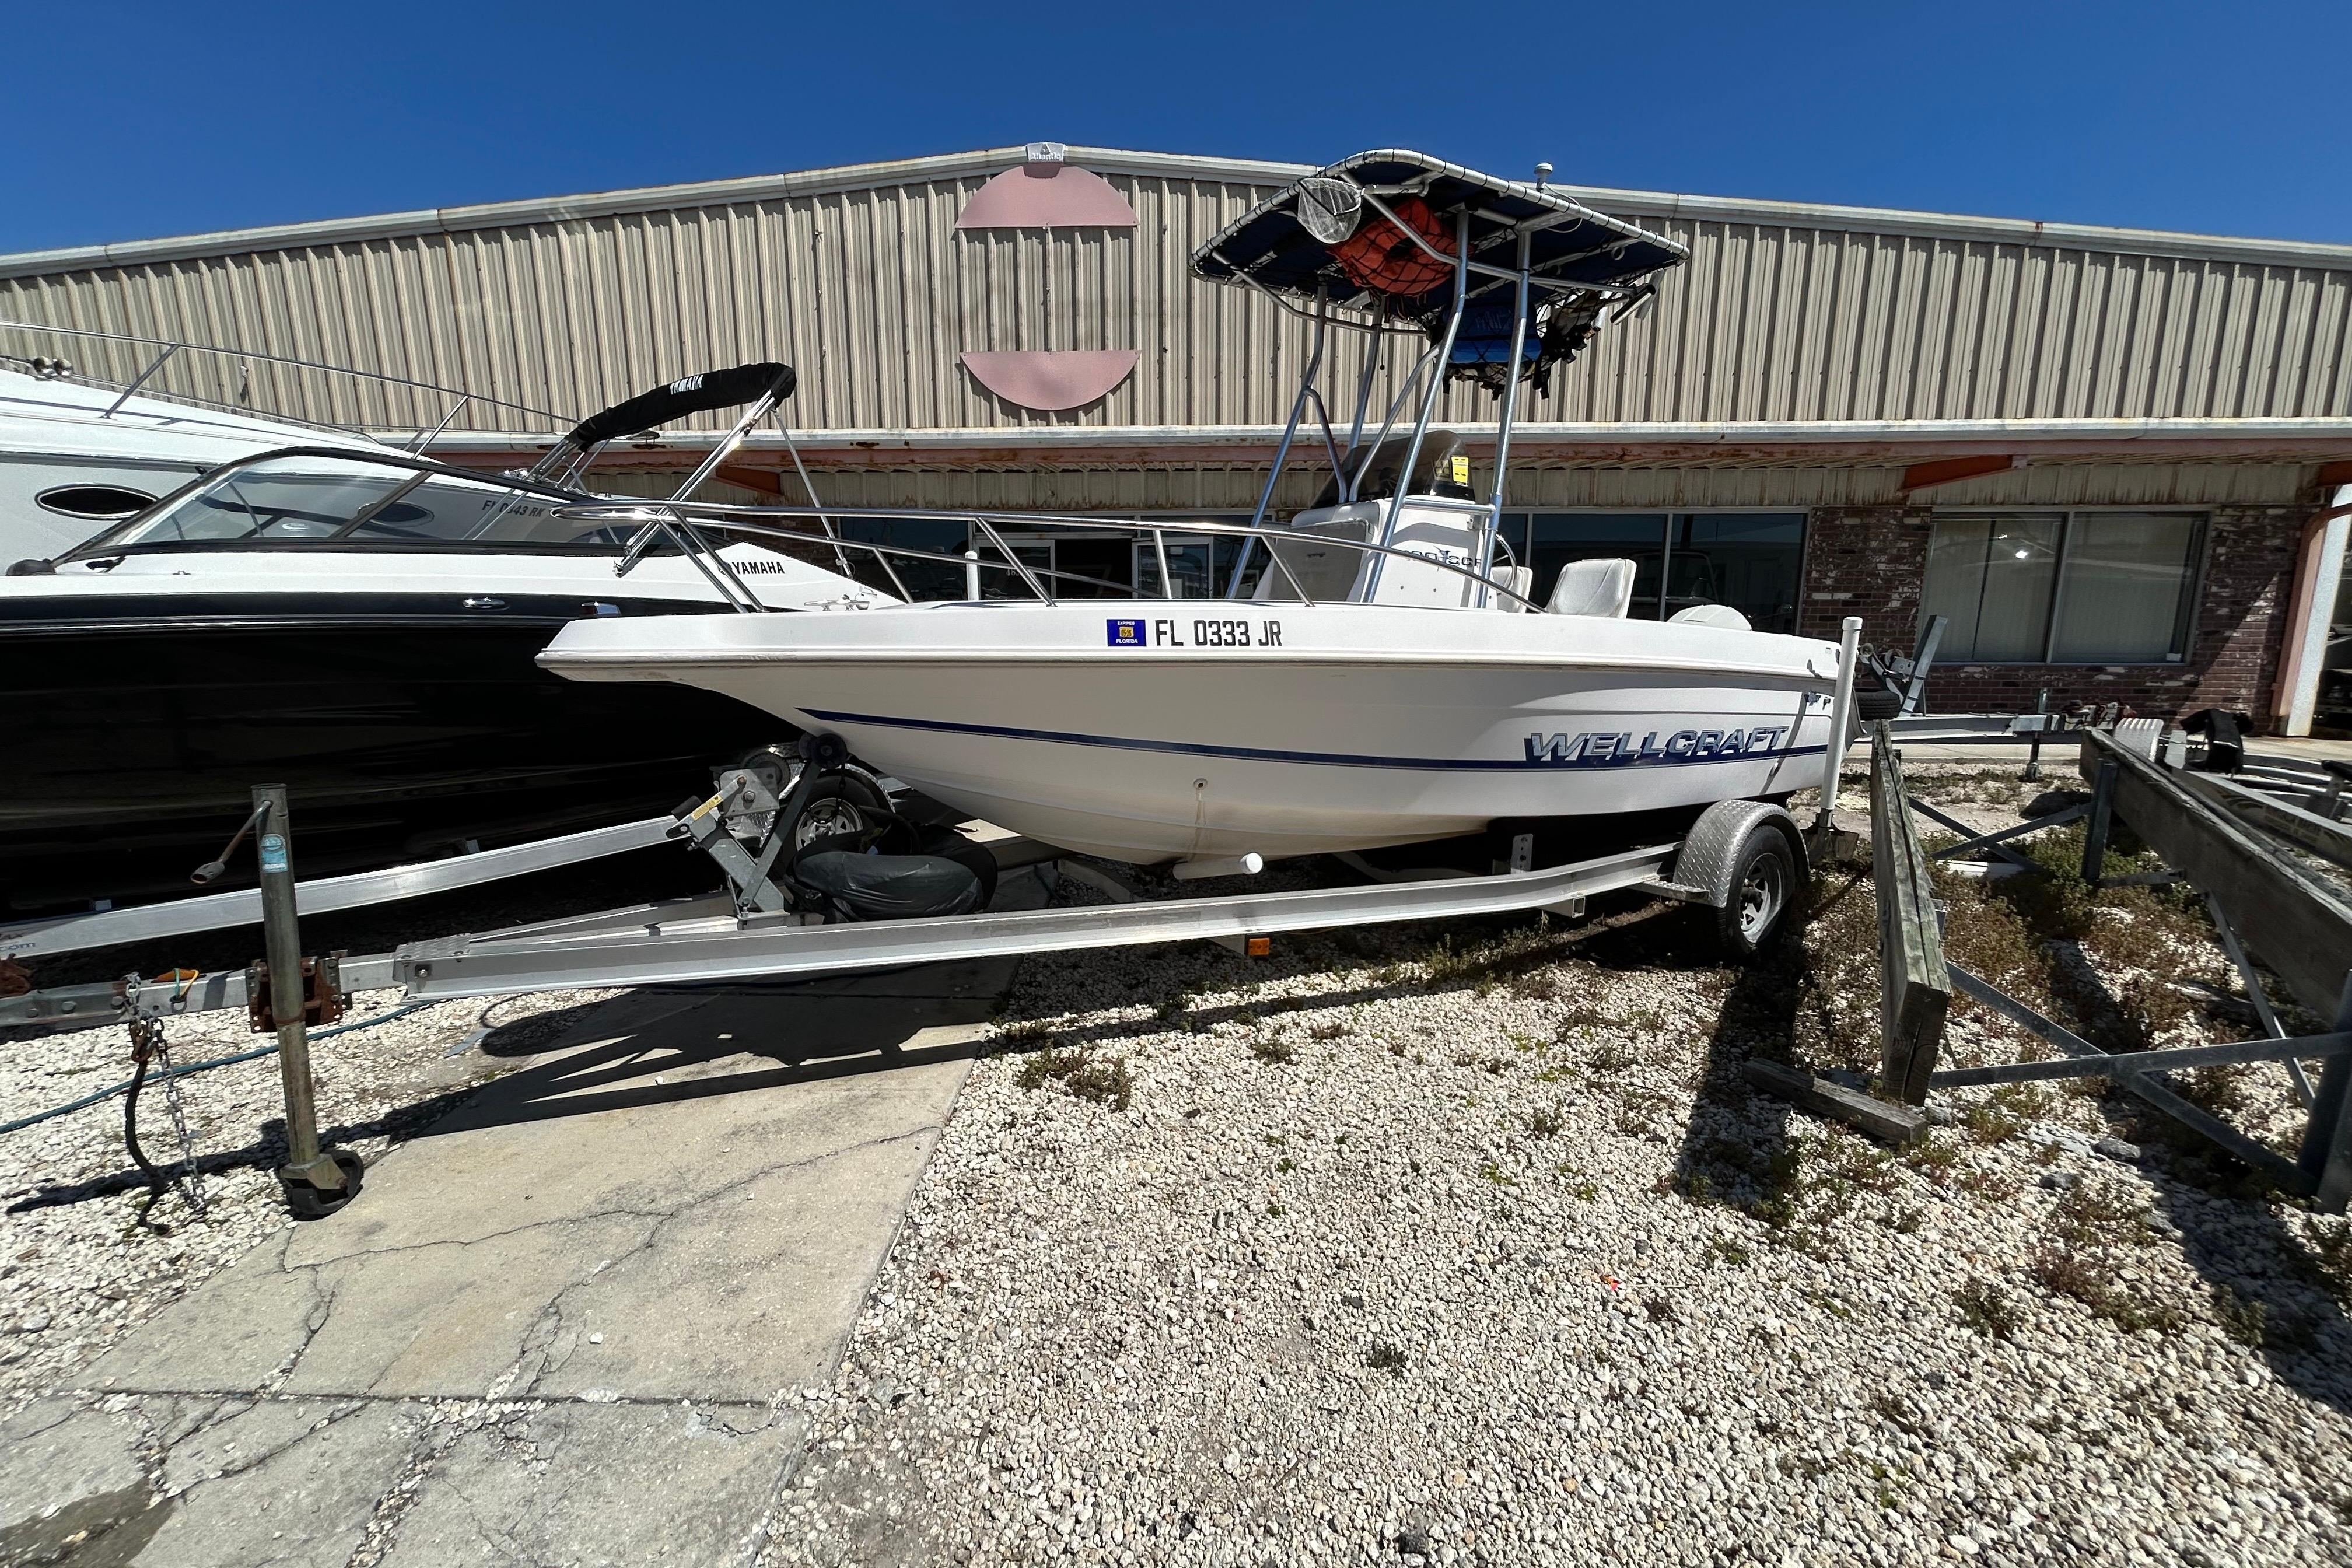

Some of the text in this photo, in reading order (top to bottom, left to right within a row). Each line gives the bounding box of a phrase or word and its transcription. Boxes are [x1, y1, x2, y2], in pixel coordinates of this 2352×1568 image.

[528, 507, 545, 517] RK
[732, 561, 785, 575] YAMAHA
[1155, 620, 1282, 646] FL 0333 JR
[1524, 725, 1790, 761] WELLCRAFT
